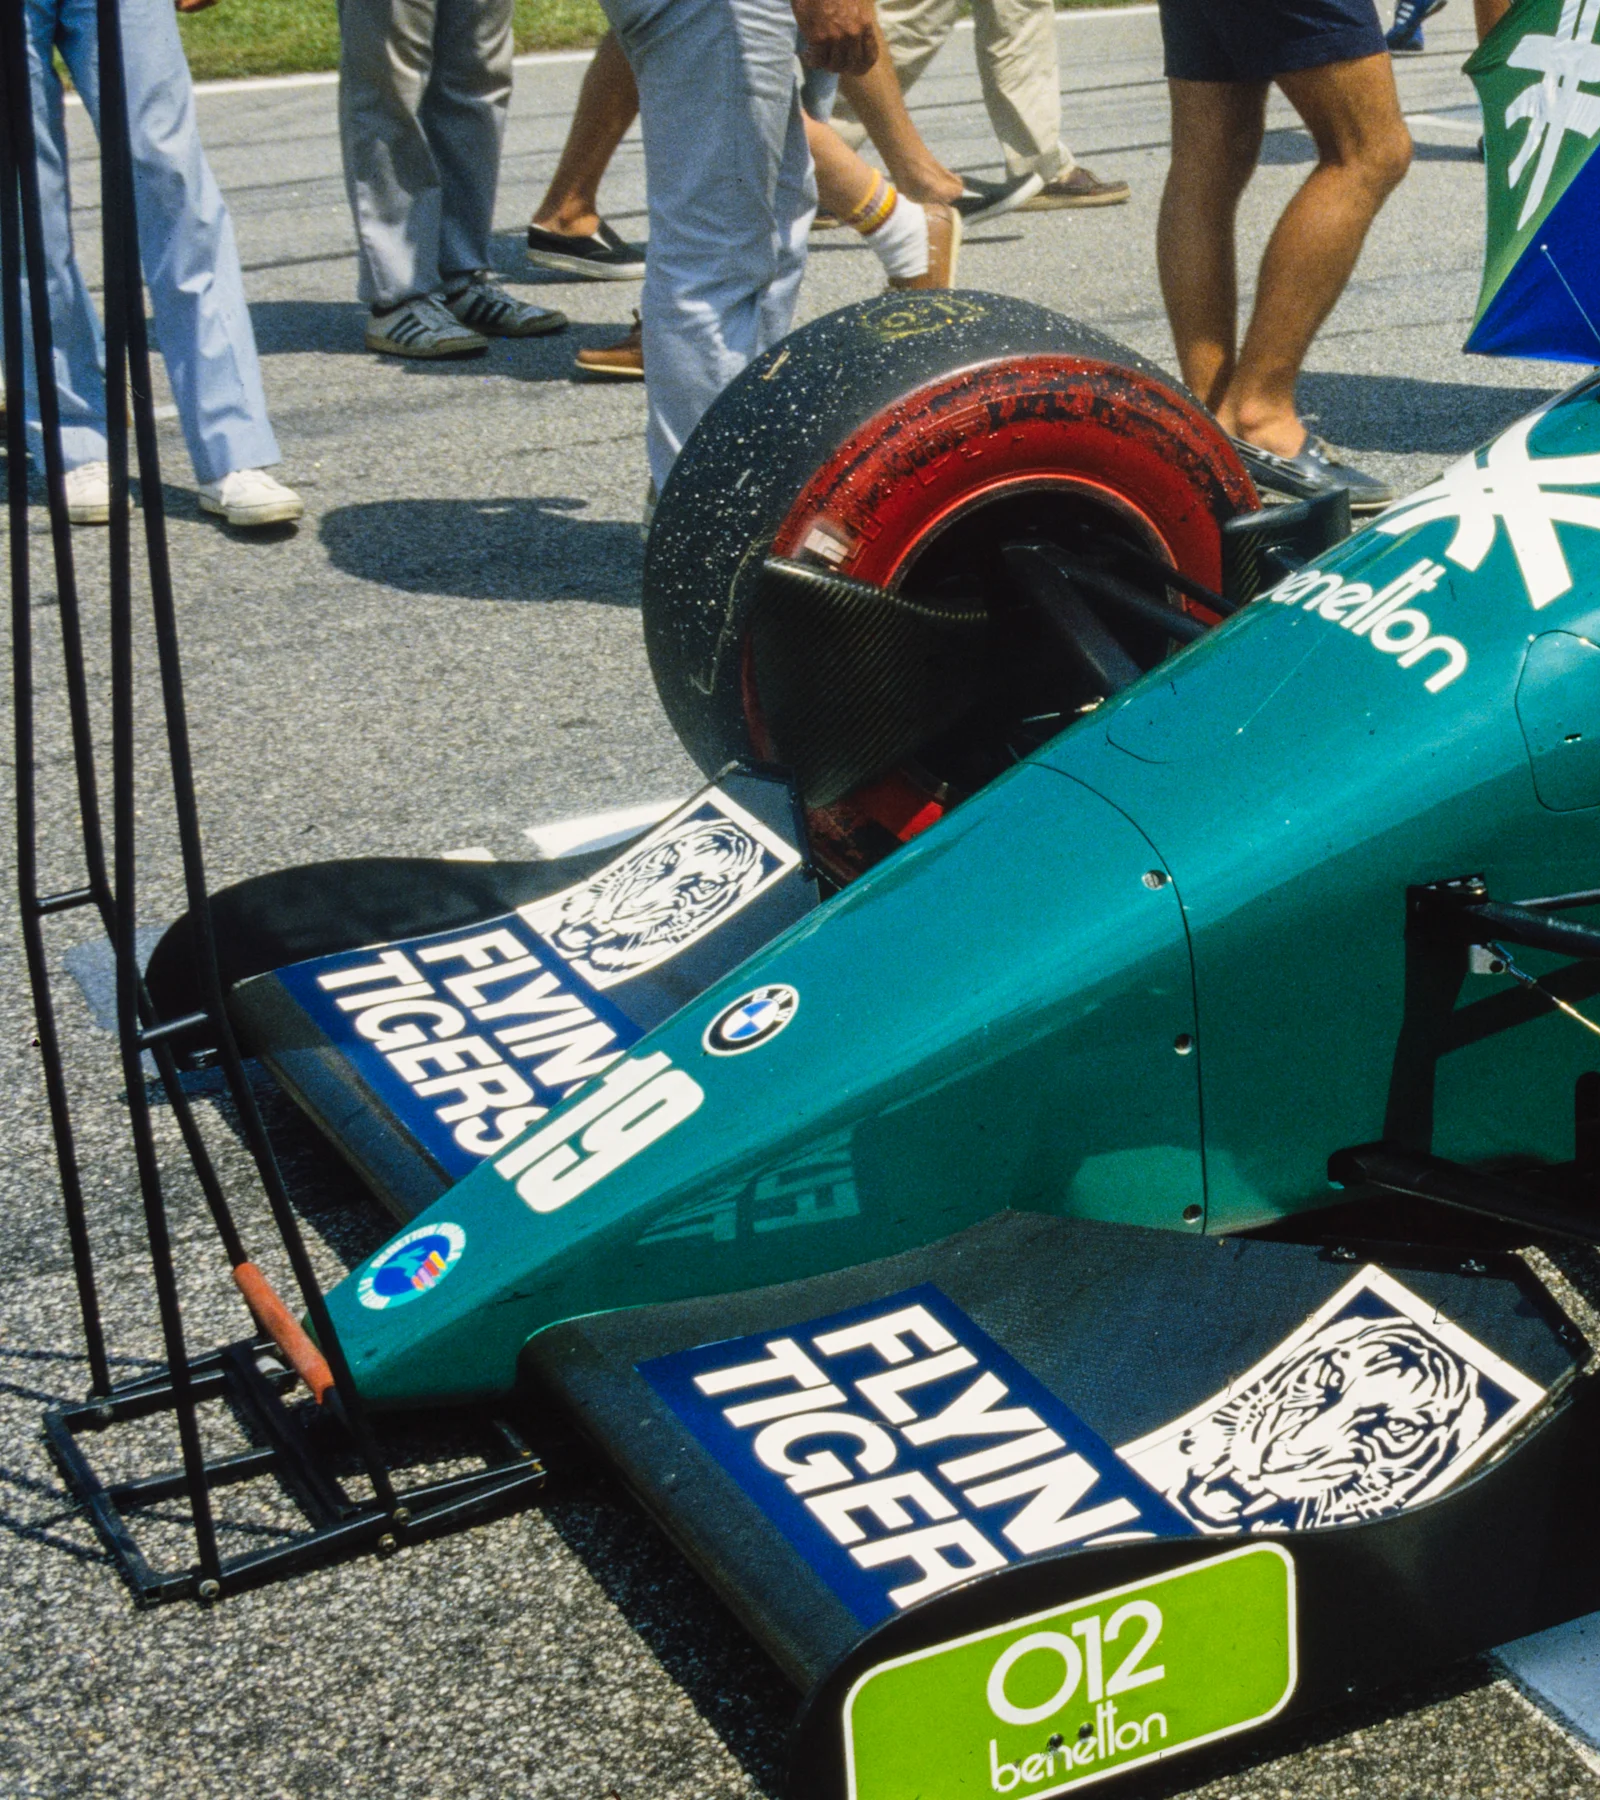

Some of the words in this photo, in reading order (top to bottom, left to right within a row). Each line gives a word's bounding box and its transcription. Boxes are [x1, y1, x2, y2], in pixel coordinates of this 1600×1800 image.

[417, 929, 627, 1101] FLYIN
[493, 1051, 705, 1214] 19
[693, 1337, 1010, 1610] TIGER
[814, 1303, 1161, 1553] FLYIN
[986, 1599, 1166, 1726] 012
[989, 1699, 1168, 1793] benetton
